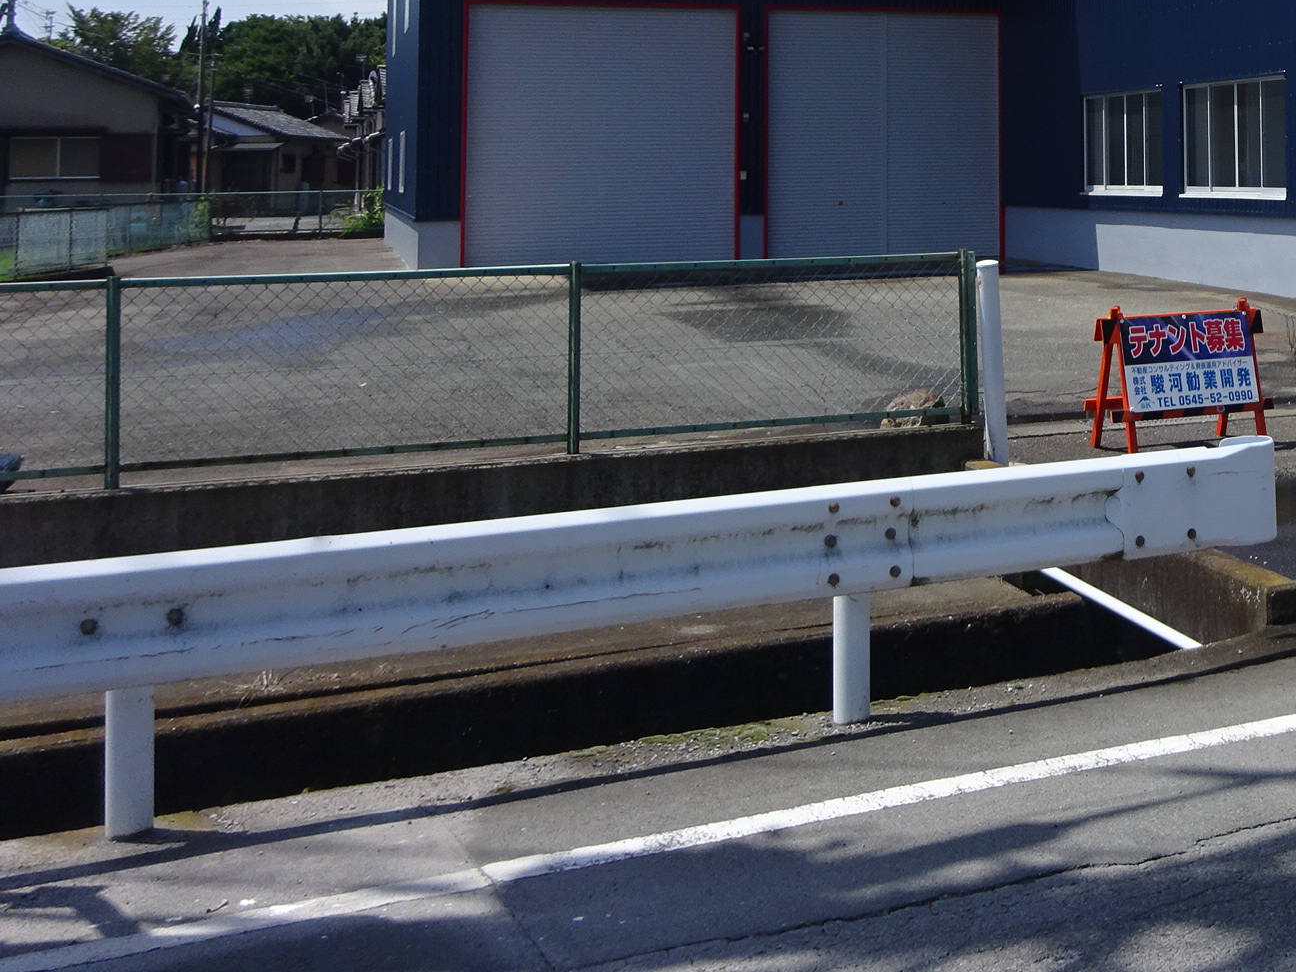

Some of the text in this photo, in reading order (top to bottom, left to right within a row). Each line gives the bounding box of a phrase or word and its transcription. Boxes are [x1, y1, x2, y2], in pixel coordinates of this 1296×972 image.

[1128, 318, 1246, 358] テナント募集
[1157, 390, 1253, 408] TEL 0545-52-0990
